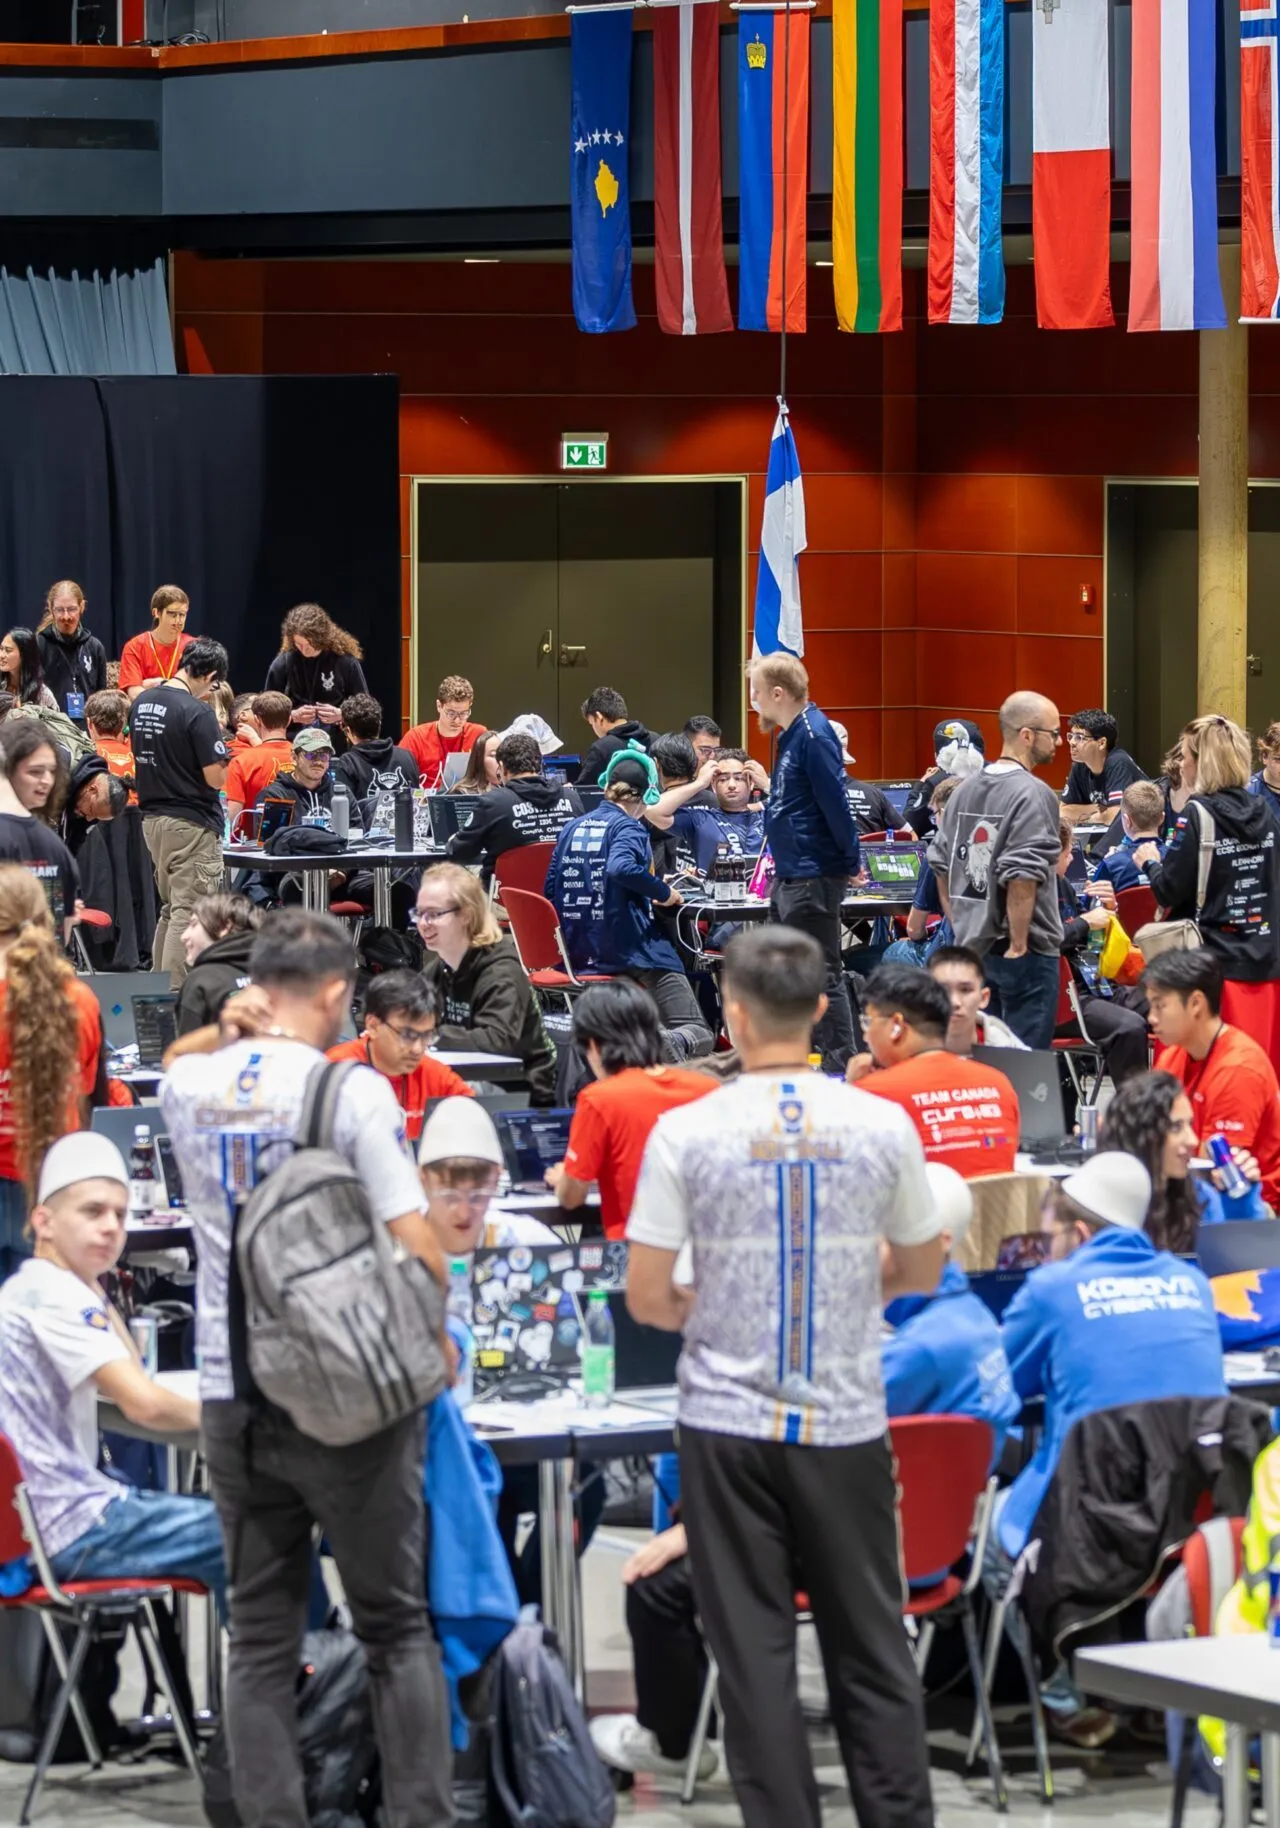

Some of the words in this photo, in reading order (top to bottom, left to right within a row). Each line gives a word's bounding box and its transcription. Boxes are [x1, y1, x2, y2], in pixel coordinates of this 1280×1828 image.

[912, 1091, 951, 1107] TEAM
[951, 1086, 1001, 1103] CANADA
[1076, 1274, 1200, 1305] KOSOVA
